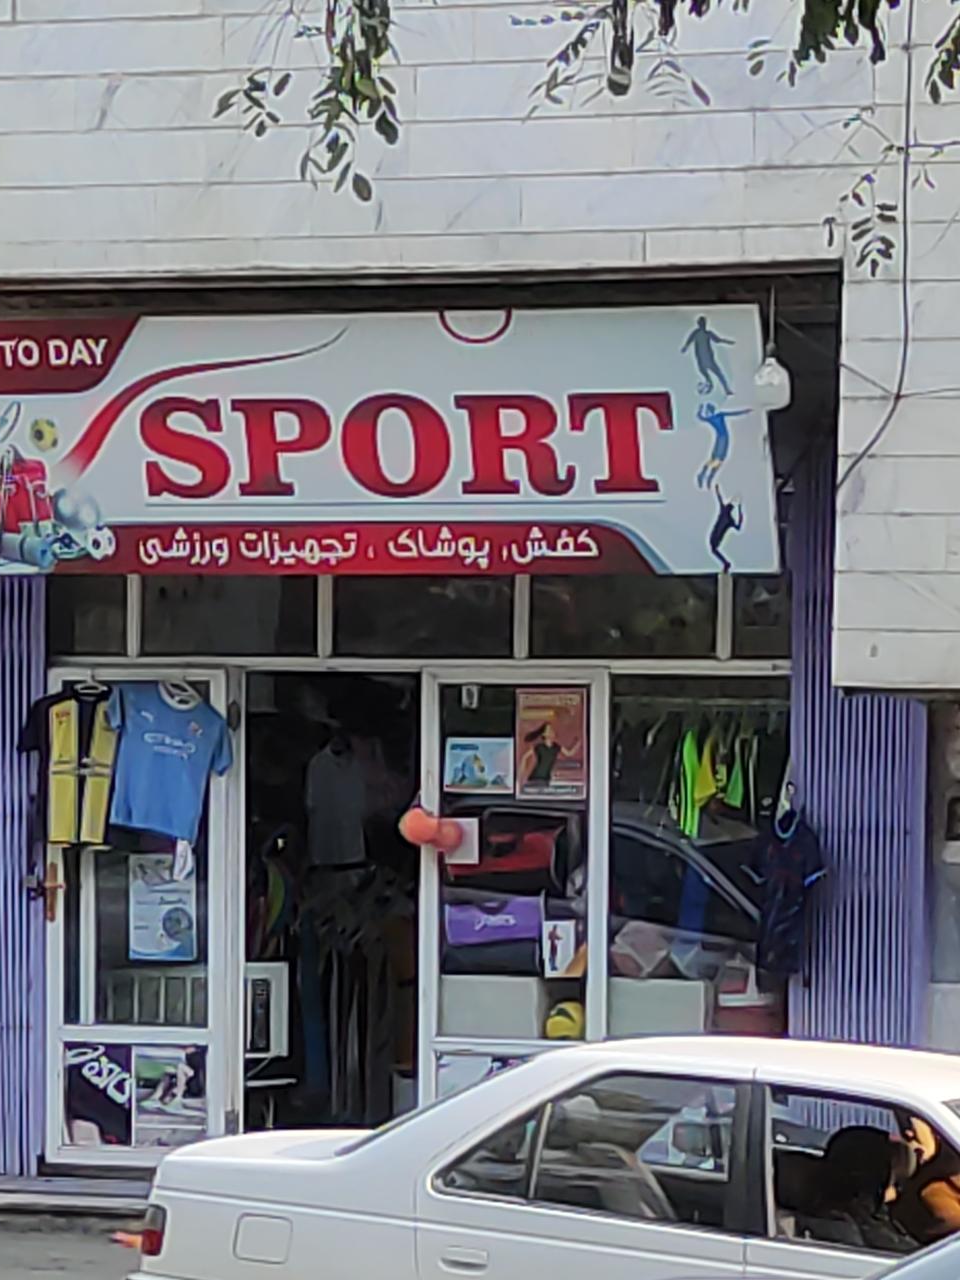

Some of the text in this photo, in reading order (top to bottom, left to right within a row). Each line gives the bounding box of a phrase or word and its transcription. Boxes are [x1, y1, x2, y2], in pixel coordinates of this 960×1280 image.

[47, 338, 108, 366] DAY
[140, 391, 674, 498] SPORT
[139, 526, 229, 565] ورزشی
[240, 530, 358, 565] تجهیزات
